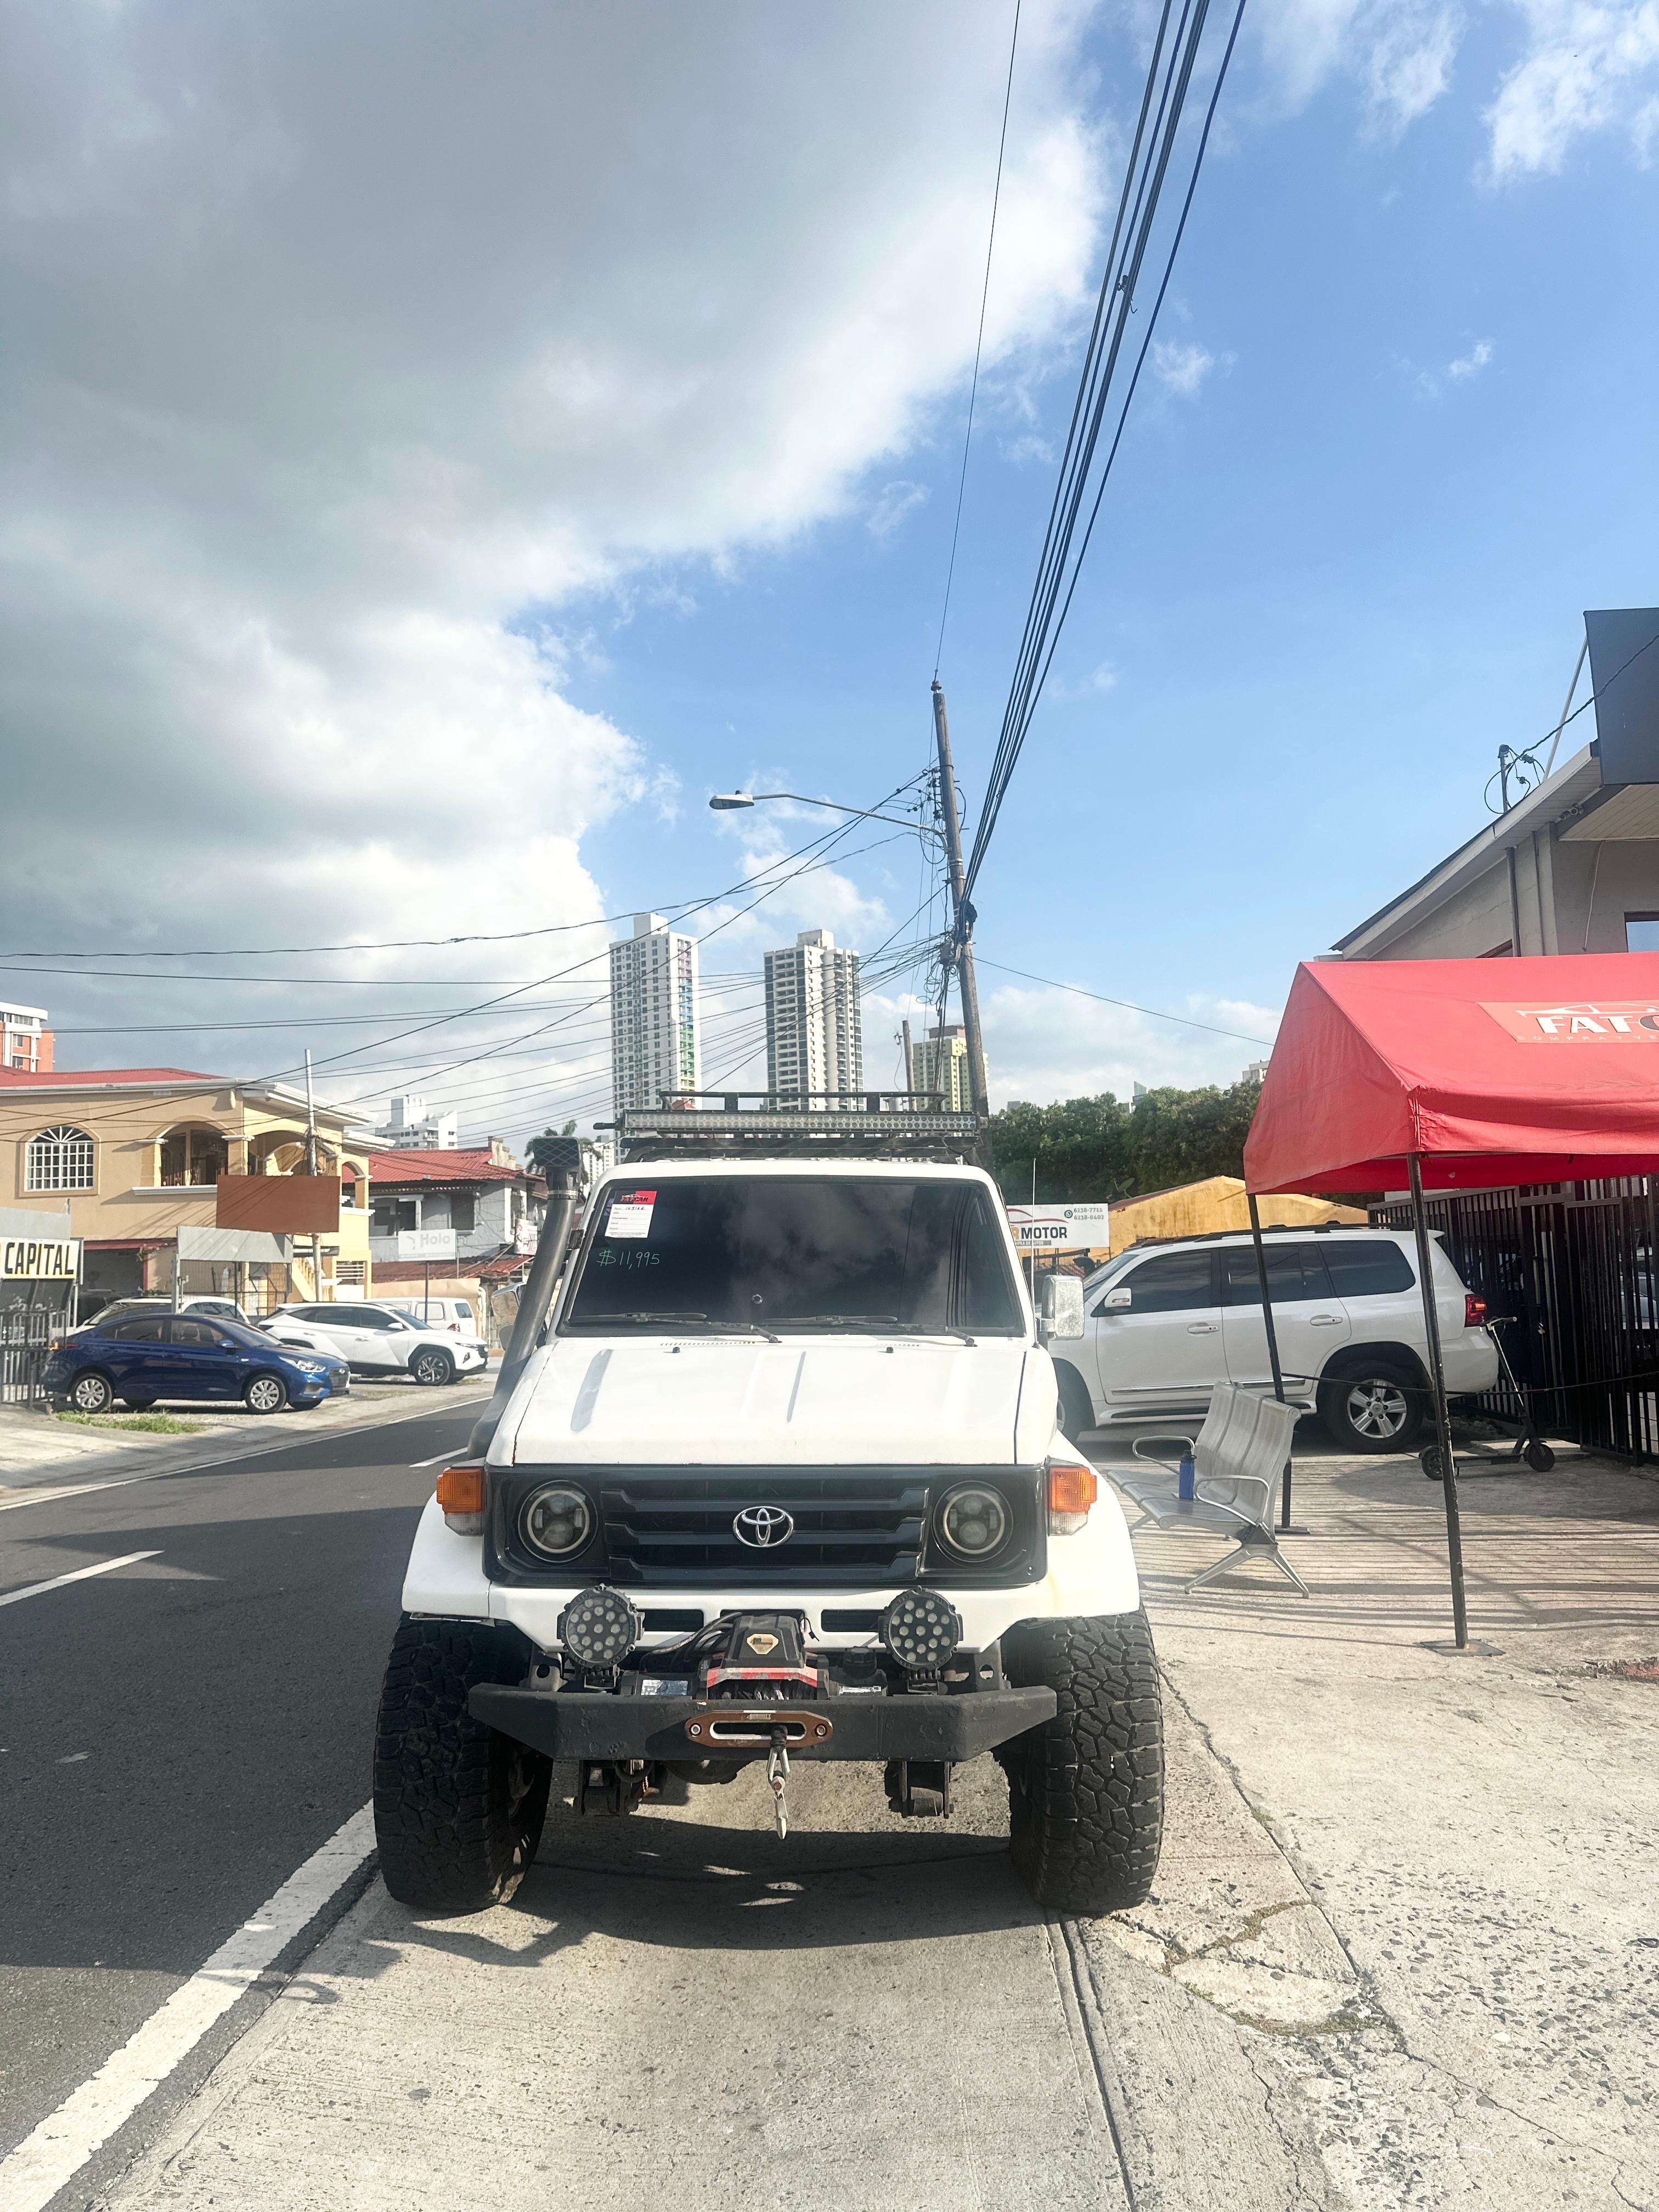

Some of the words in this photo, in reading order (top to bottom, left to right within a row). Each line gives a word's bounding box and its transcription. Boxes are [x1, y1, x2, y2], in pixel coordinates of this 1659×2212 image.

[1021, 1226, 1068, 1239] MOTOR
[4, 1242, 75, 1276] CAPITAL
[596, 1249, 660, 1269] $11,995
